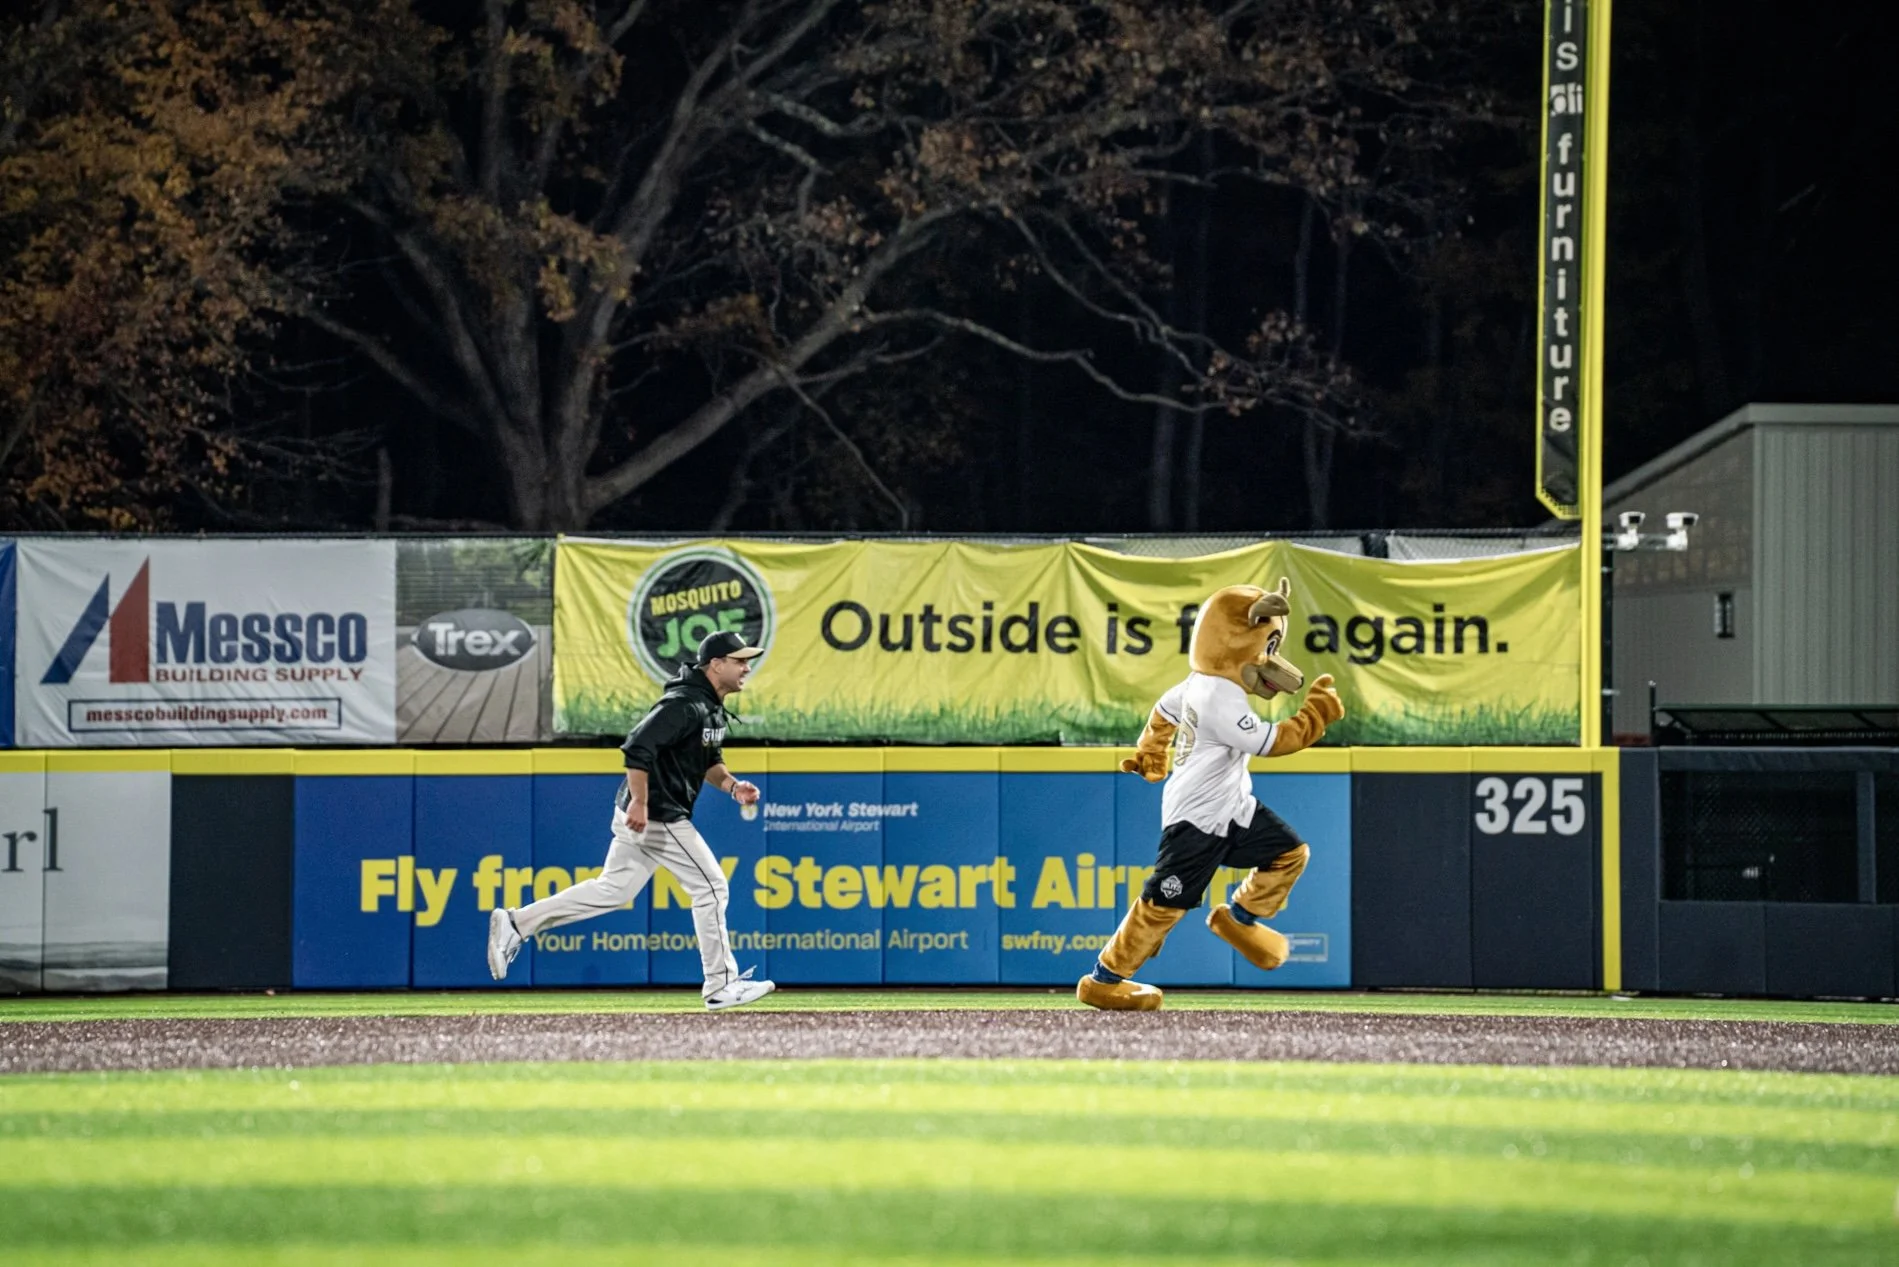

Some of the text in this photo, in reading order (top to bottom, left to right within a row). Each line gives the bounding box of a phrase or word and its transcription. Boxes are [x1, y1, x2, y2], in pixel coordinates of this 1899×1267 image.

[1550, 132, 1576, 432] furniture
[650, 579, 742, 617] MOSQUITO
[156, 601, 368, 664] Messco
[426, 621, 521, 657] Trex
[657, 607, 746, 658] JOE
[821, 601, 1083, 655] Outside
[1106, 603, 1154, 656] is
[1304, 602, 1511, 666] again.
[156, 667, 364, 683] BUILDING SUPPLY
[86, 704, 328, 724] messcobuildingsupply.com
[763, 801, 919, 818] New York Stewart
[1475, 777, 1586, 836] 325
[763, 819, 881, 834] International Airport
[360, 855, 459, 927] Fly
[472, 854, 634, 911] fro
[753, 854, 1016, 911] Stewart
[534, 928, 969, 953] Your Hometow International Airport
